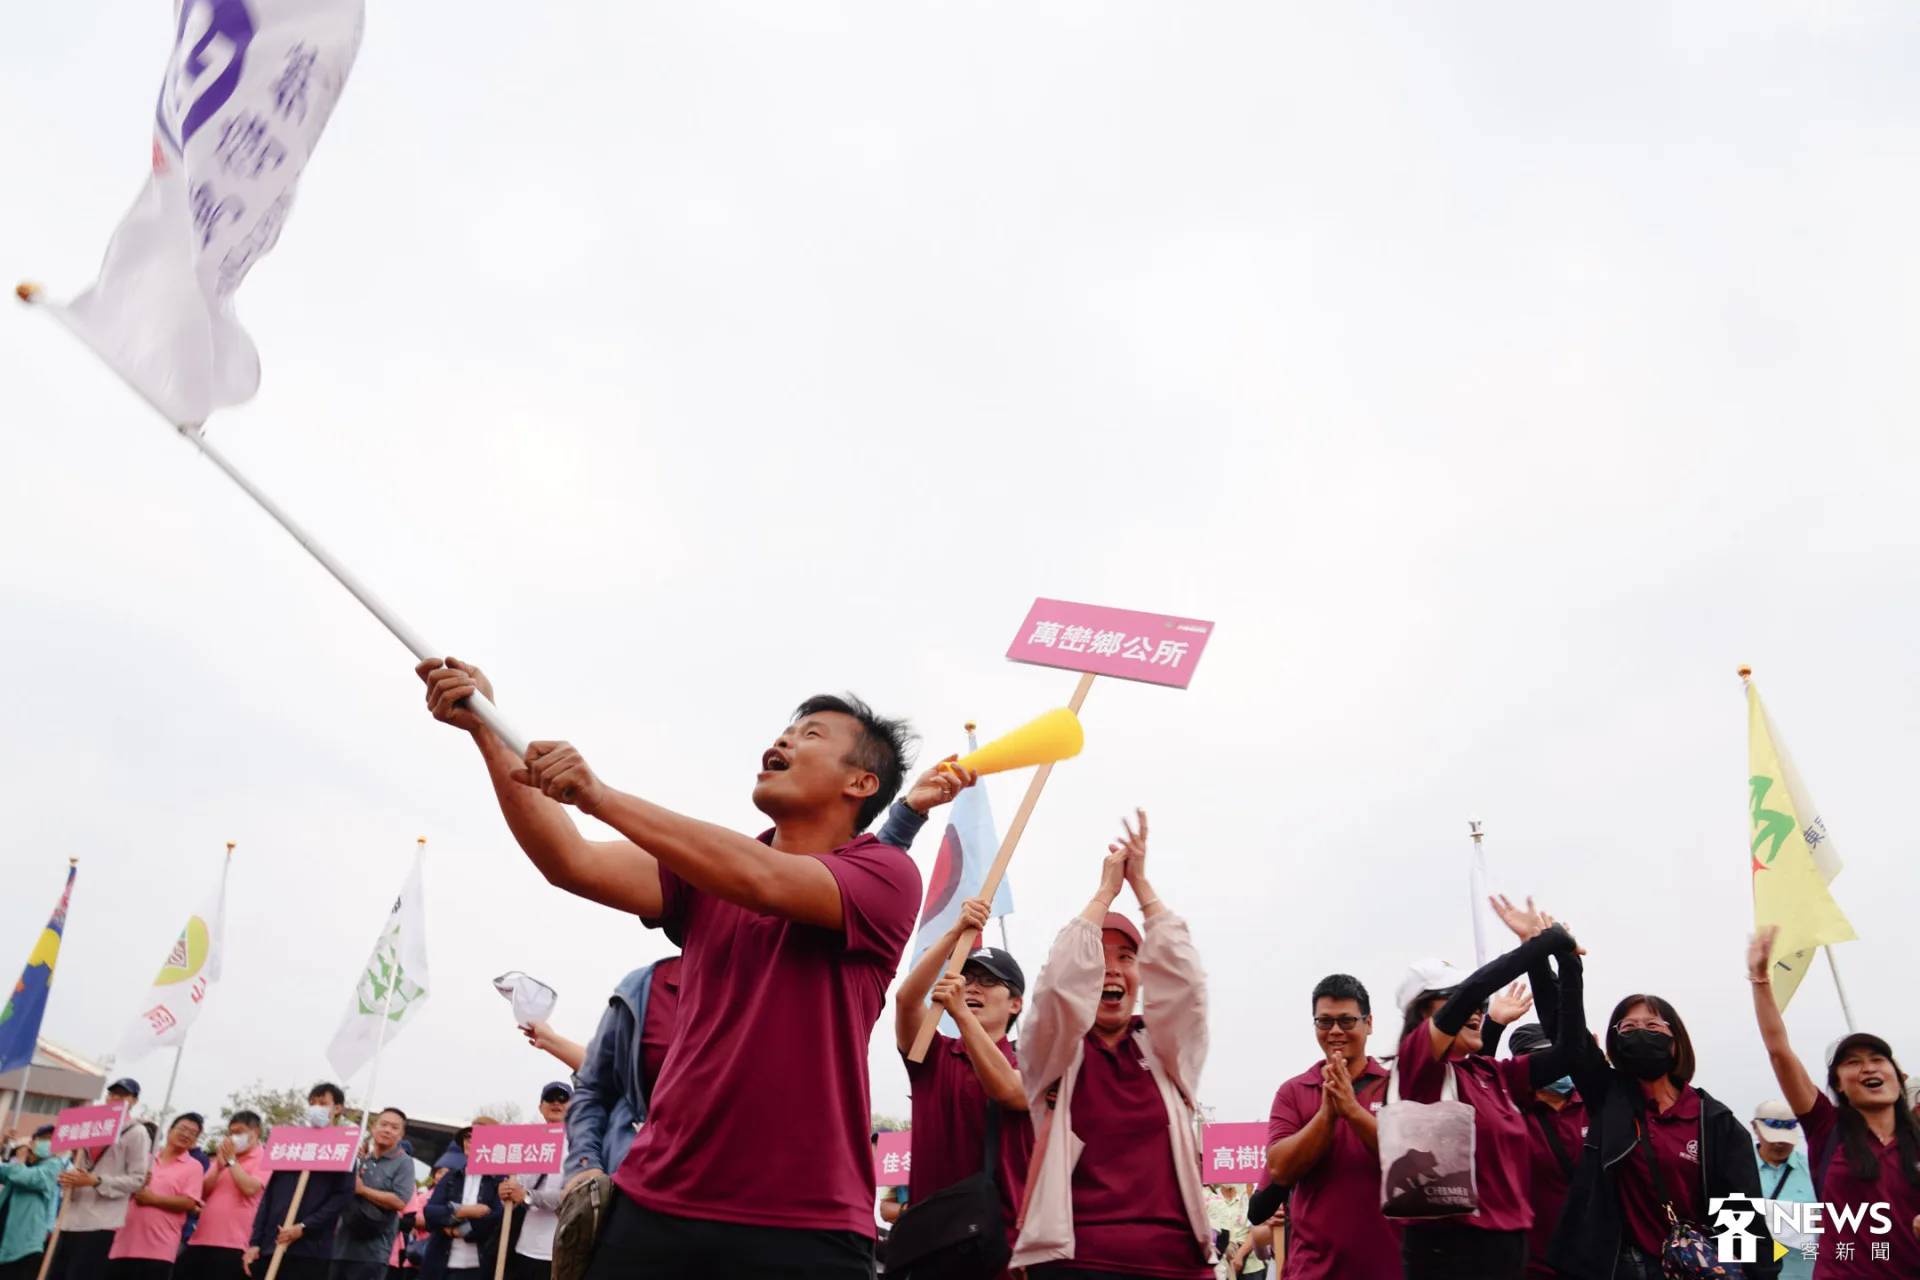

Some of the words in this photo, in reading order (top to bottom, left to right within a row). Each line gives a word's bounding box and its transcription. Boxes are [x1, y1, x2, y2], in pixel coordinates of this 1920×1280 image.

[1028, 621, 1190, 667] 萬巒鄉公所
[270, 1143, 350, 1162] 杉林區公所
